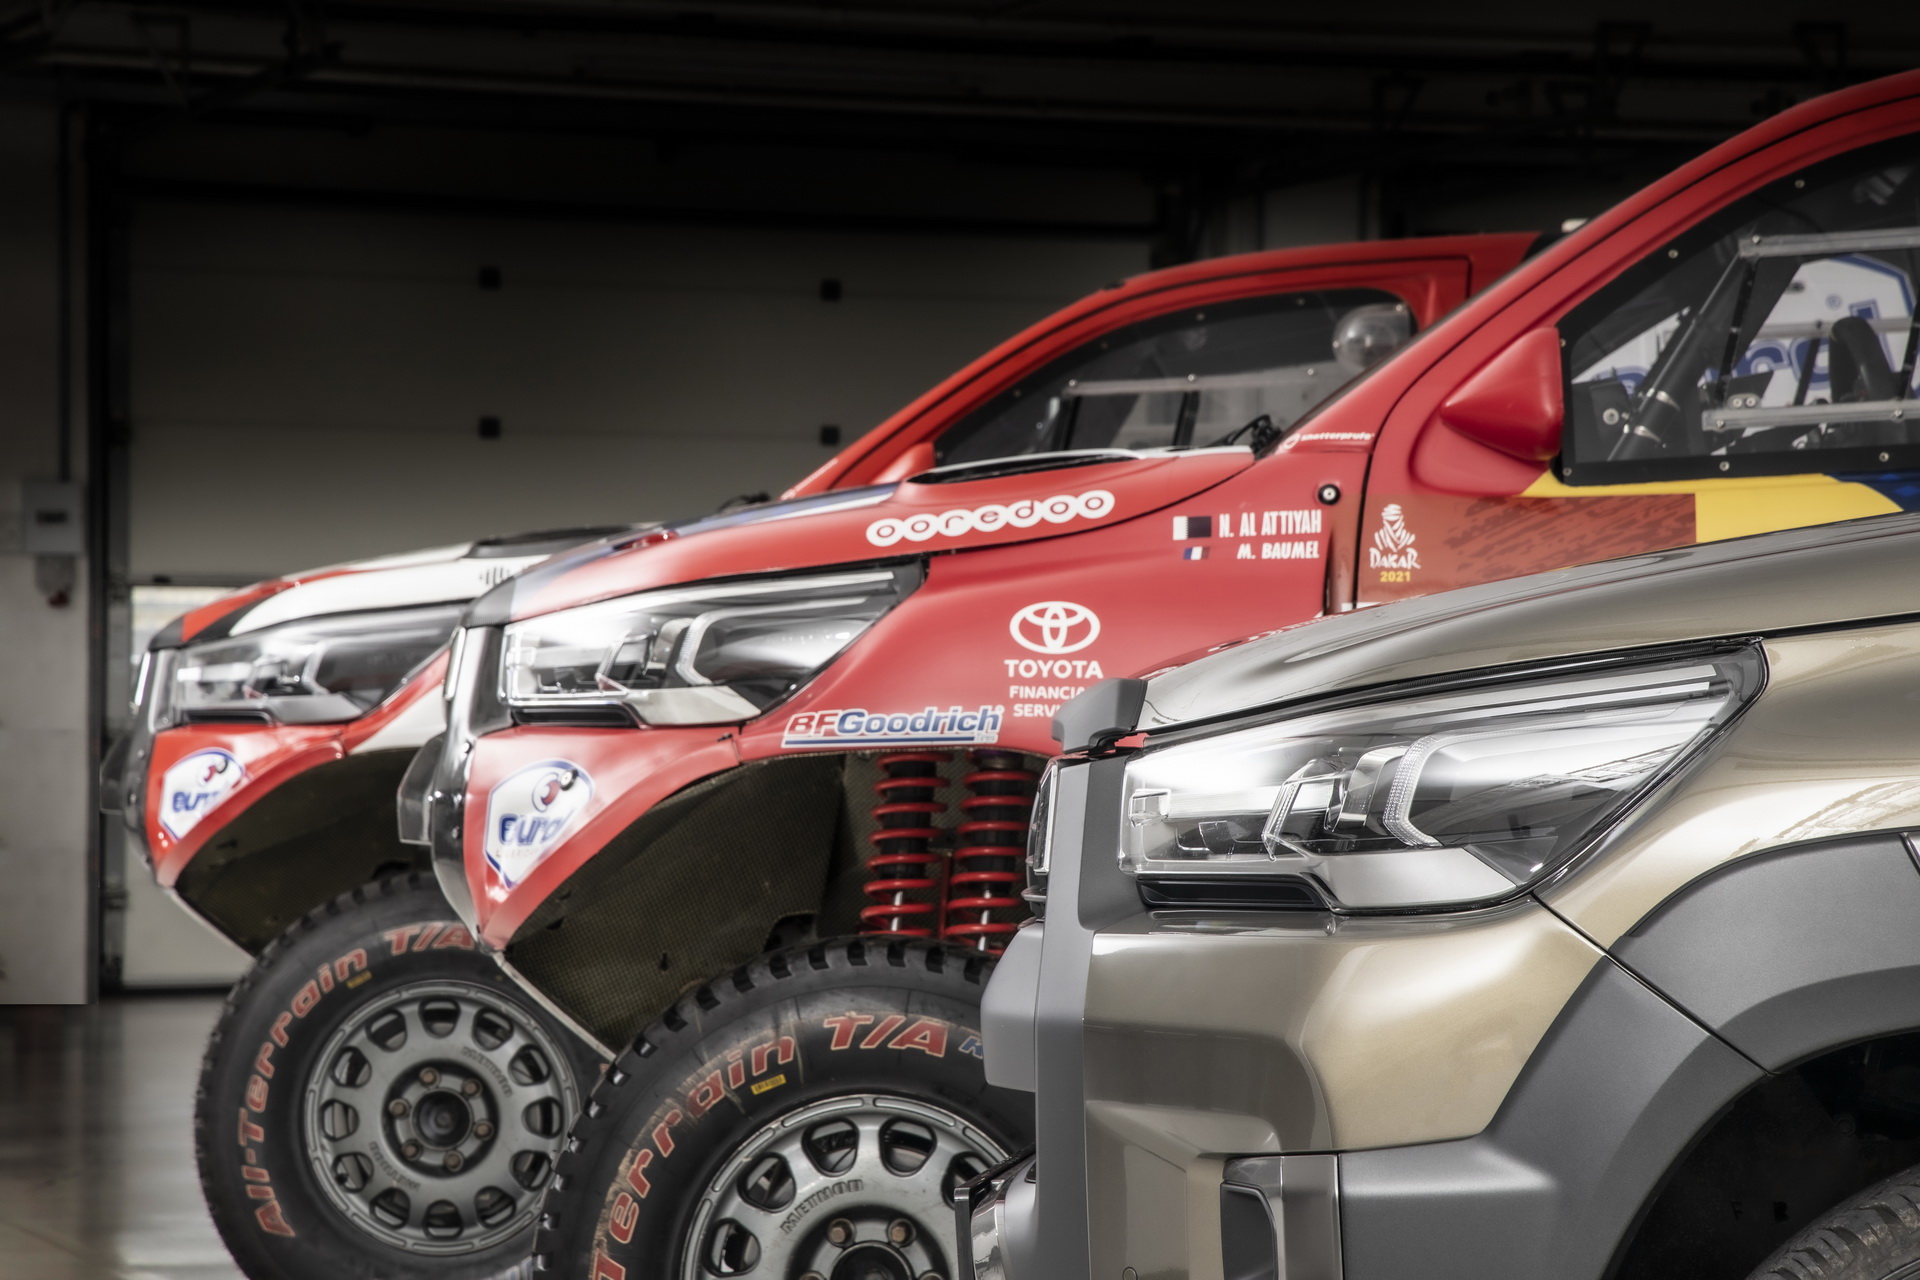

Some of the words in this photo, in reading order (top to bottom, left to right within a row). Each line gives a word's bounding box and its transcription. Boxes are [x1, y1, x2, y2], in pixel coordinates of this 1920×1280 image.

[866, 490, 1115, 547] ooredoo
[1218, 513, 1235, 538] N.
[1239, 512, 1257, 537] AL
[1260, 509, 1323, 536] ATTIYAH
[1236, 543, 1256, 560] M.
[1260, 541, 1320, 560] BAUMEL
[1379, 570, 1412, 583] 2021
[1003, 658, 1105, 679] TOYOTA
[785, 705, 1002, 737] BFGoodrich
[823, 1013, 950, 1058] T/A
[237, 947, 369, 1238] All-Terrain
[383, 920, 475, 957] T/A
[779, 1179, 864, 1234] METHOD
